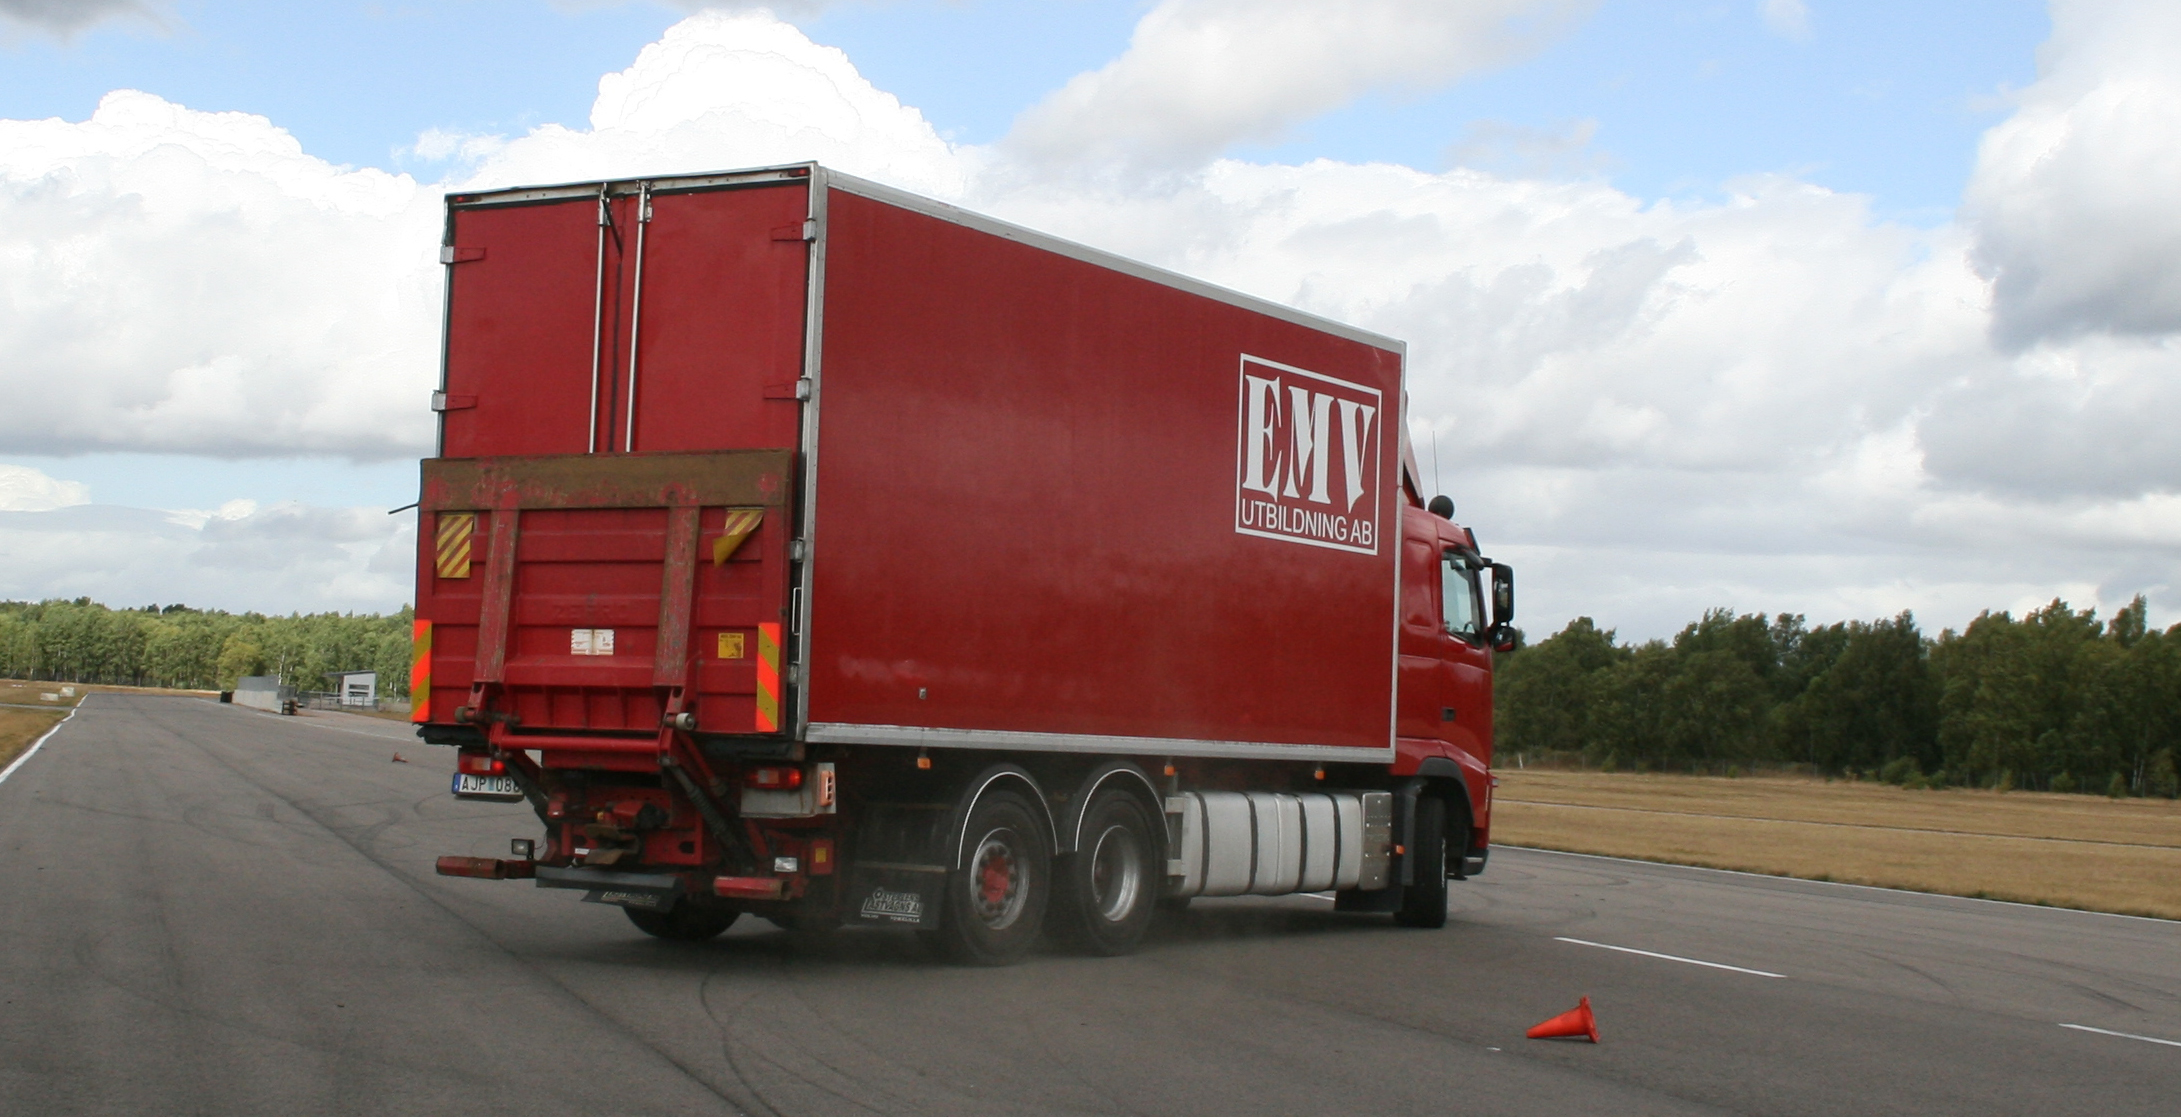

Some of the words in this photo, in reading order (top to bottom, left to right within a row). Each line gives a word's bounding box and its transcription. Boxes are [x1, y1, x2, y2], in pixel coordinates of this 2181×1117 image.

[1243, 375, 1376, 514] EMV
[1242, 499, 1347, 541] UTBILDNING
[1350, 519, 1373, 544] AB
[462, 776, 487, 792] AJP
